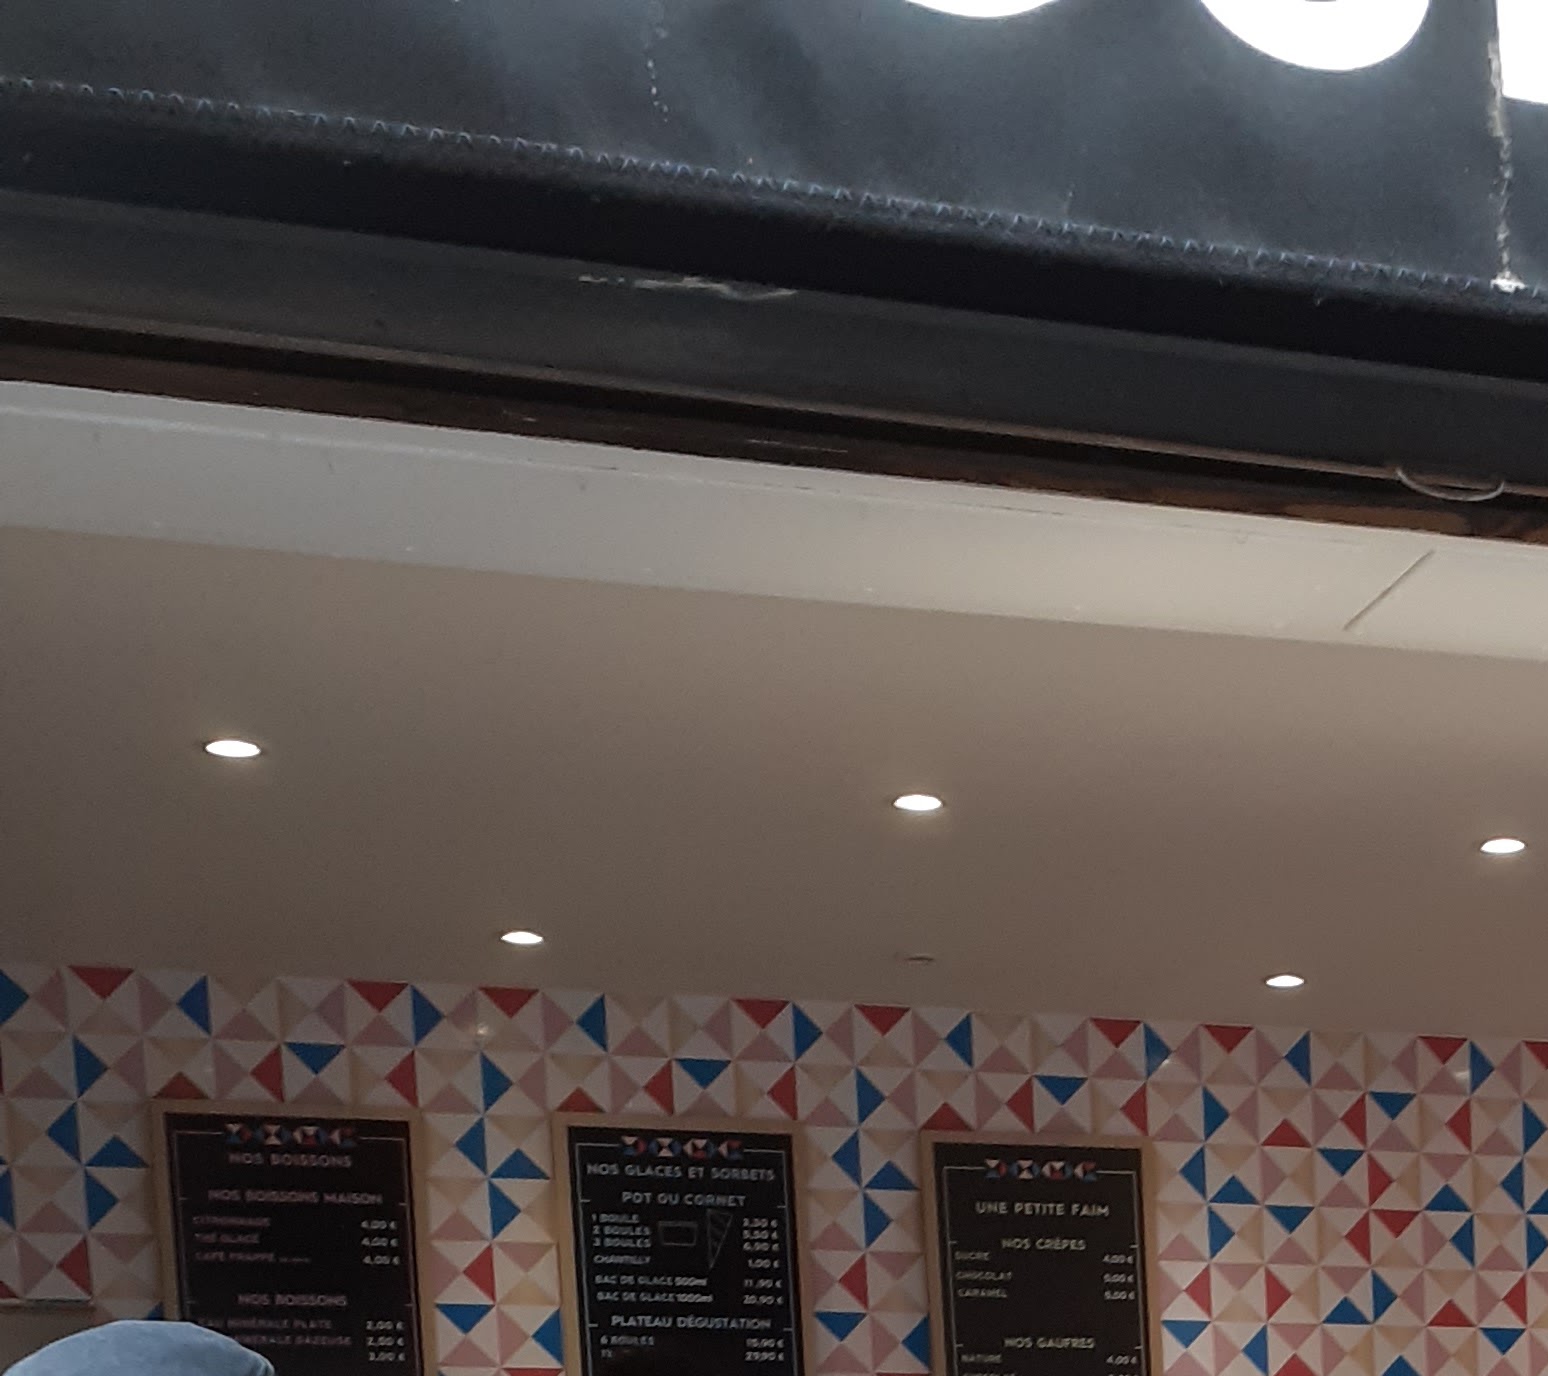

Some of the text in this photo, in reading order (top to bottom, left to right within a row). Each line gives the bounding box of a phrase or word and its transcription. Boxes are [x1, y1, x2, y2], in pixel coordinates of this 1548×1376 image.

[587, 1163, 775, 1181] NOS GLACES ET SORBETS
[622, 1191, 746, 1207] POT OU CORNET
[976, 1201, 1109, 1218] UNE PETITE FAIM
[1001, 1238, 1031, 1250] NOS
[611, 1313, 771, 1330] PLATEAU DÉGUSTATION
[1003, 1337, 1096, 1350] NOS GAUFRES
